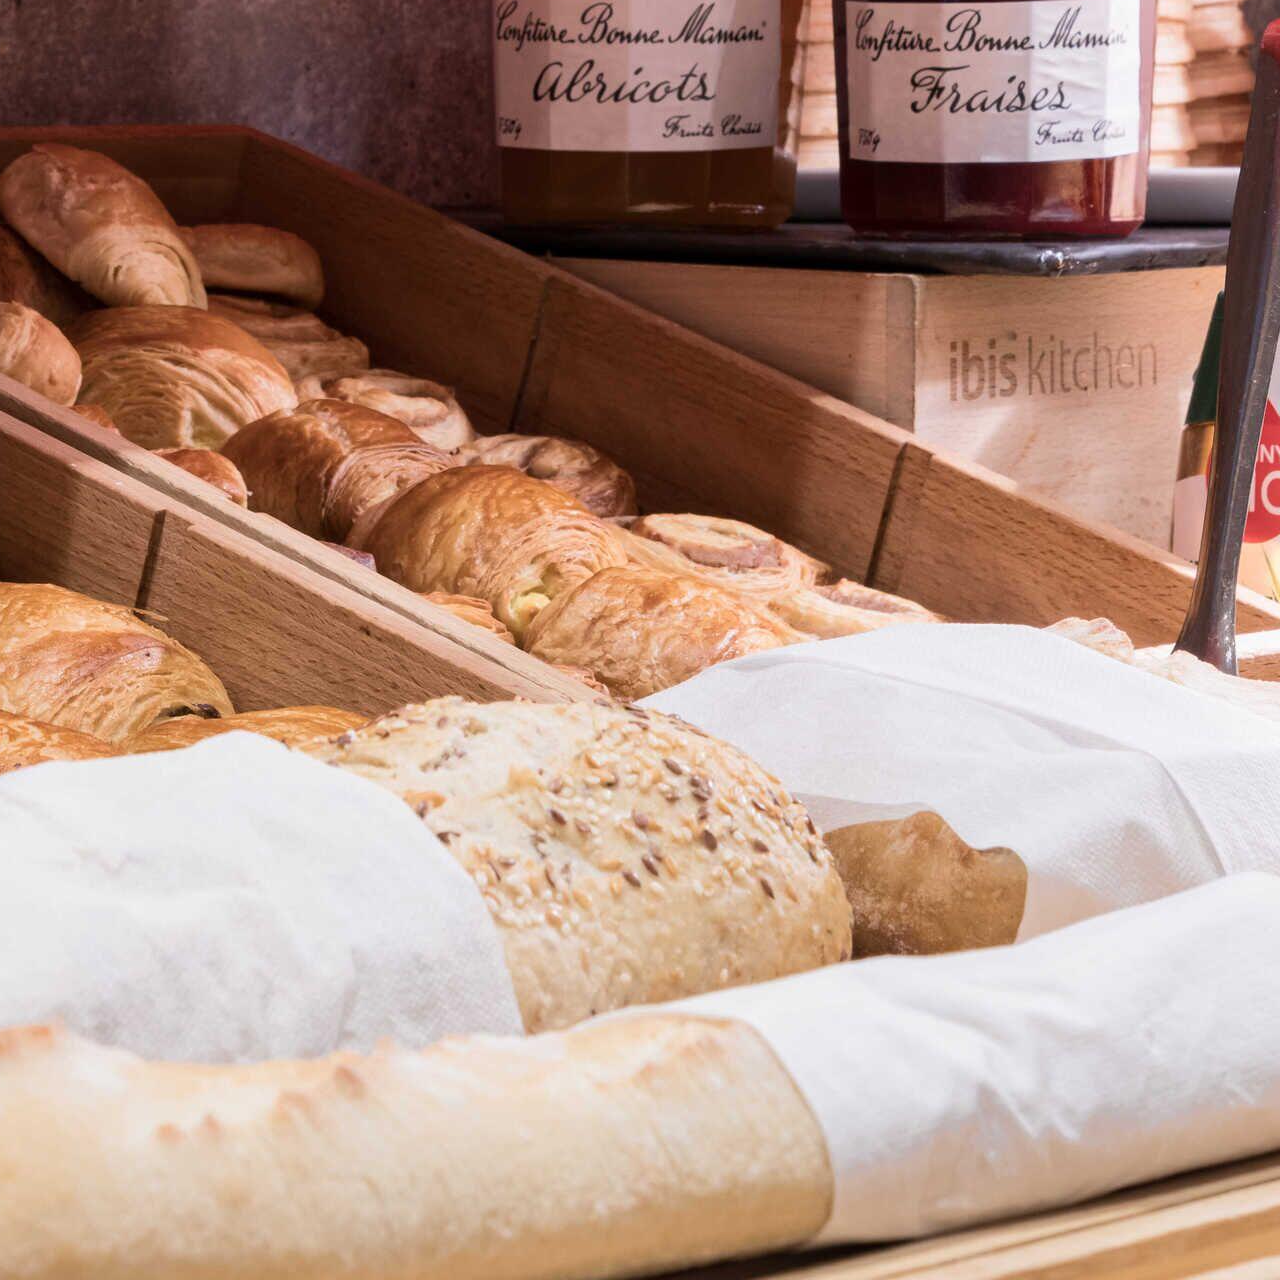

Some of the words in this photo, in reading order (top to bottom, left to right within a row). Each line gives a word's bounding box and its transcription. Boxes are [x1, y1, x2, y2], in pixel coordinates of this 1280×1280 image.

[496, 0, 576, 51] Confiture
[578, 2, 663, 45] Bonne
[669, 3, 763, 45] Maman
[855, 9, 940, 61] Confiture
[943, 9, 1035, 52] Bonne
[532, 59, 717, 104] Abricots
[910, 65, 1073, 114] Fraises
[662, 114, 715, 138] Fruits
[1035, 120, 1084, 146] Fruits
[949, 337, 1017, 401] ibis
[1027, 331, 1158, 396] kitchen
